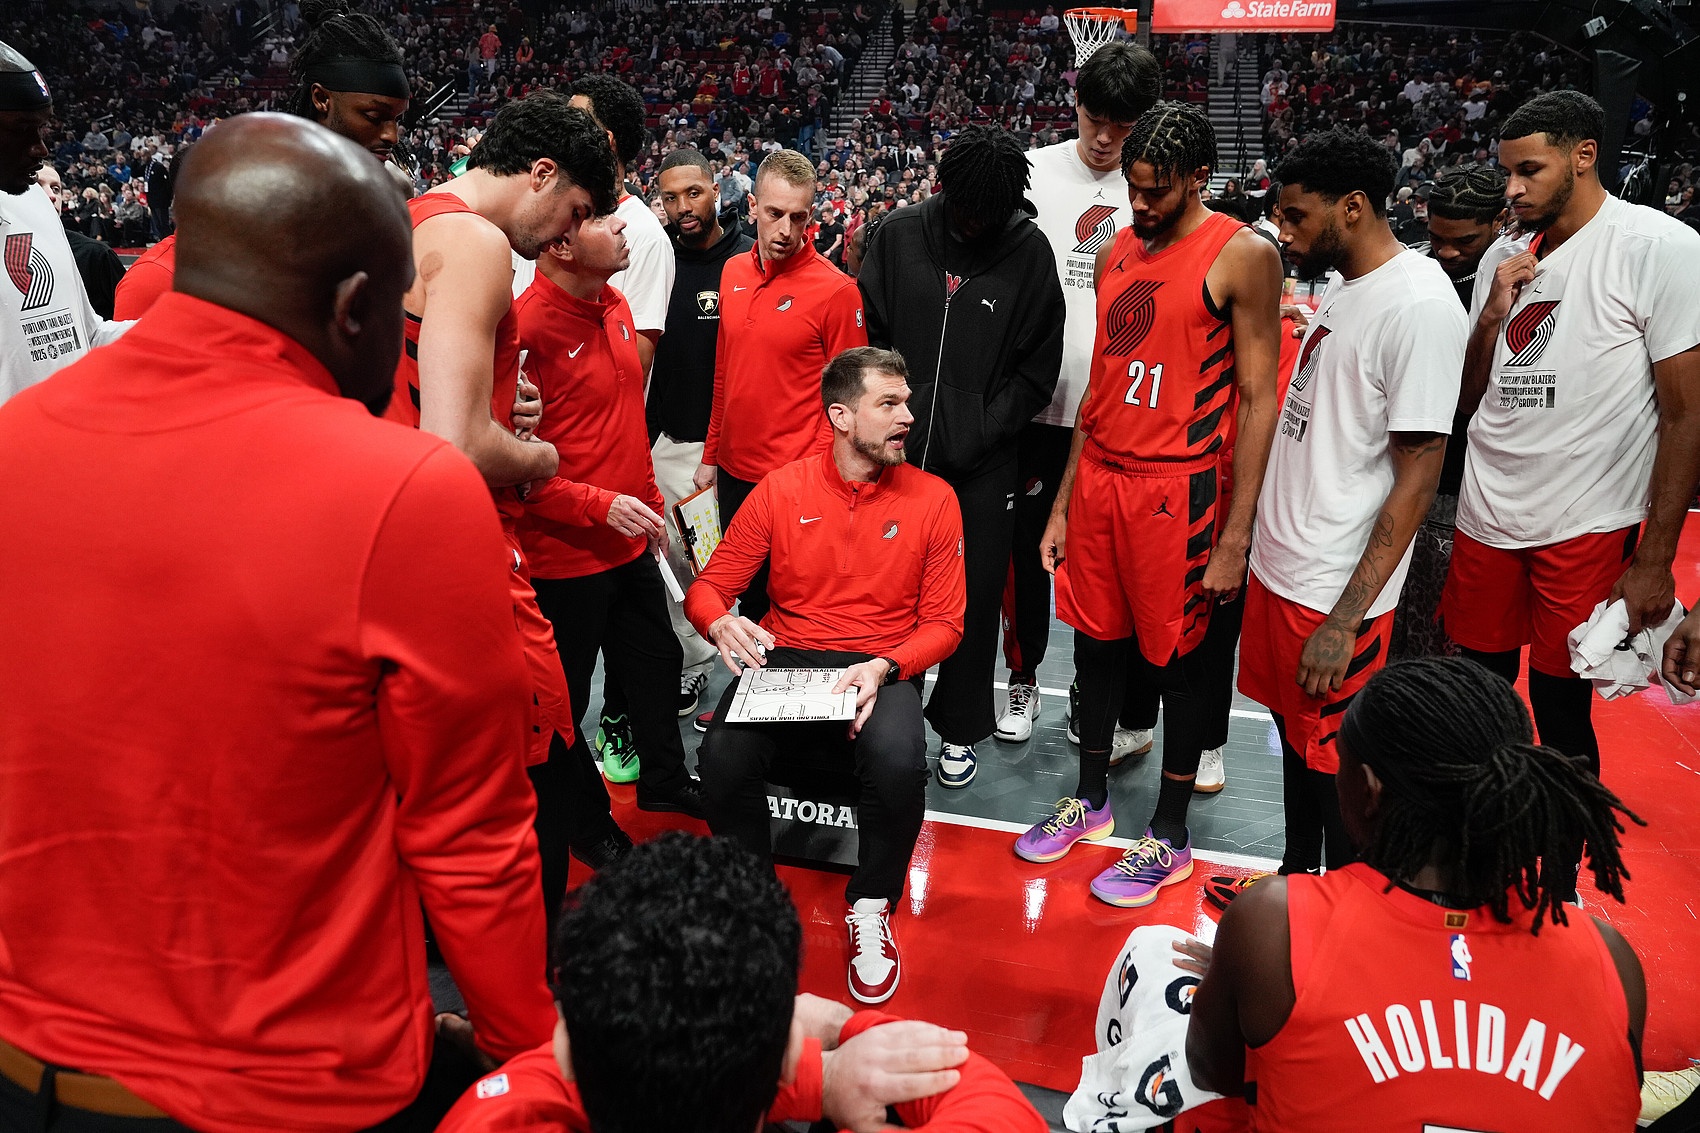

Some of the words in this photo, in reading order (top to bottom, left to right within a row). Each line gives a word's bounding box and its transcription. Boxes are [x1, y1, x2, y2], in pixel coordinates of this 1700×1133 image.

[22, 320, 48, 335] PORTLAND
[31, 349, 48, 361] 2025
[1124, 360, 1164, 410] 21
[1531, 374, 1556, 385] BLAZERS
[1518, 397, 1538, 408] GROUP
[1540, 398, 1543, 407] C
[766, 795, 858, 829] ATORA
[1343, 999, 1586, 1101] HOLIDAY
